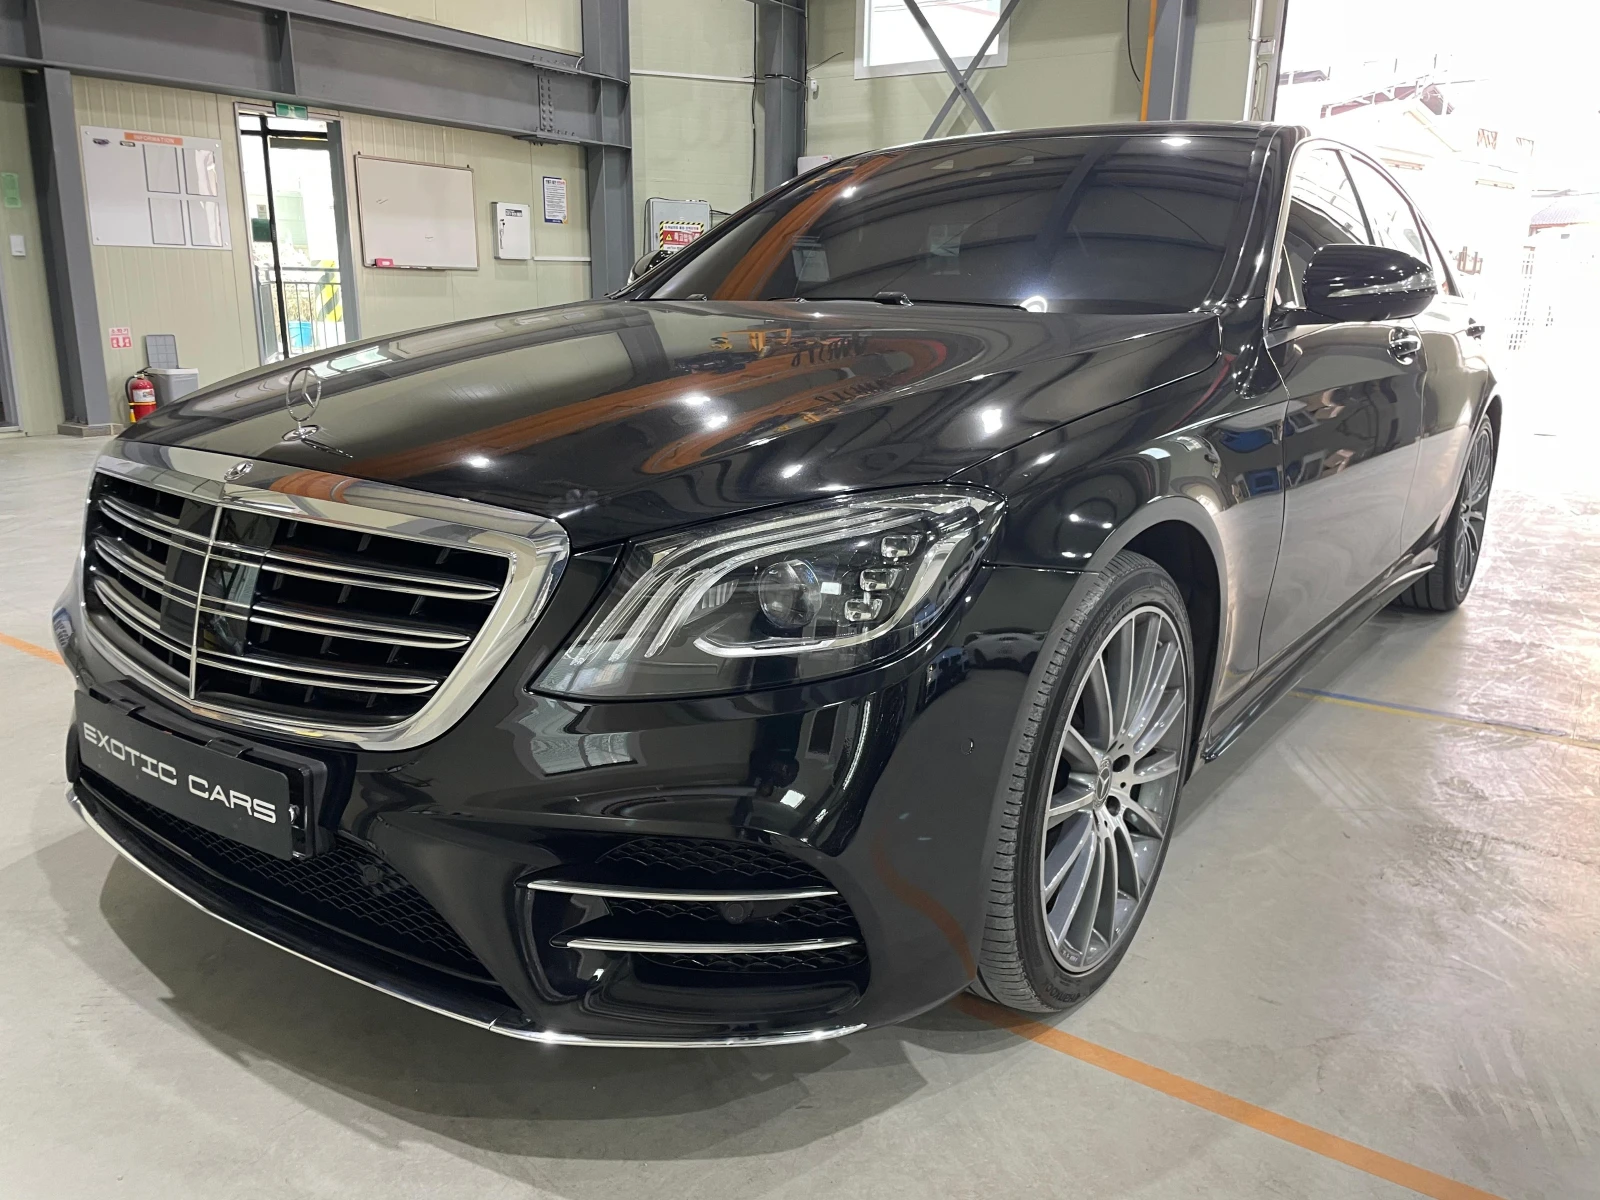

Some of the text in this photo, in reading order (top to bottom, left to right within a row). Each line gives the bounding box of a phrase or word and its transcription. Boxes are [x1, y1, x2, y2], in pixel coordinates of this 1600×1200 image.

[133, 134, 175, 144] INFORMATION
[83, 722, 276, 824] EXOTIC CARS
